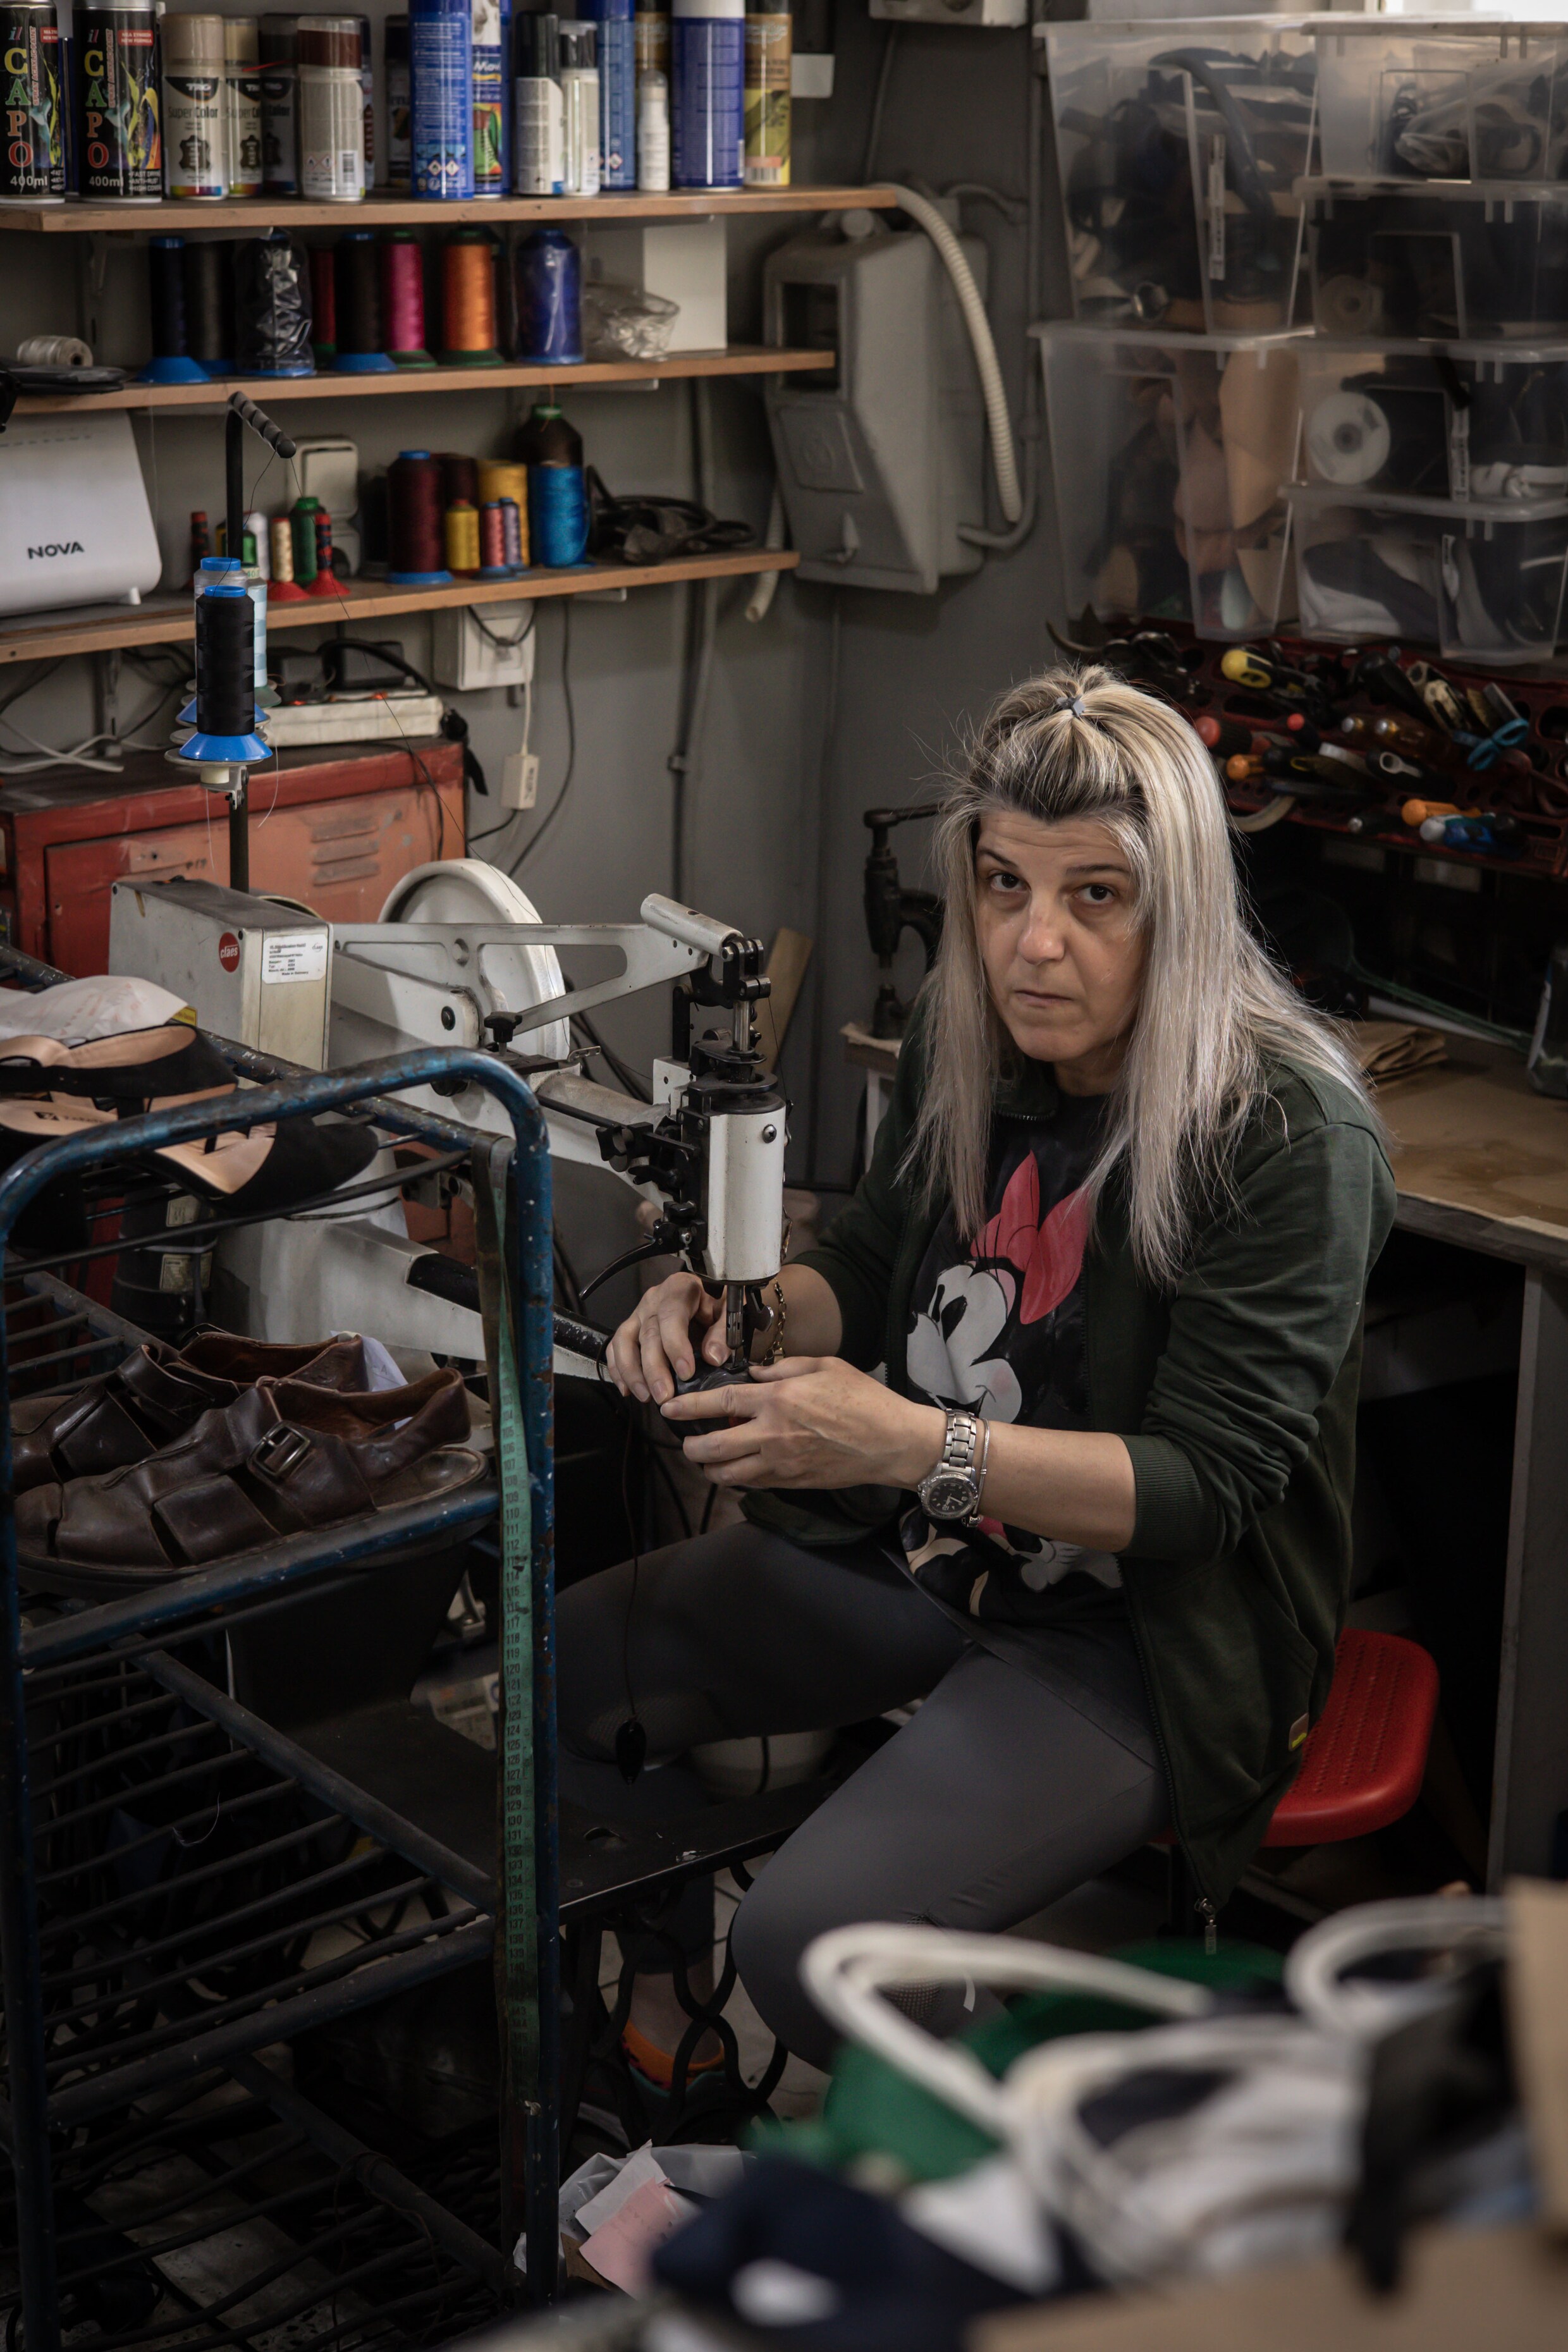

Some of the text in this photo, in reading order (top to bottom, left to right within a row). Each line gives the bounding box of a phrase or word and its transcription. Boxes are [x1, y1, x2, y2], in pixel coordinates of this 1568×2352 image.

[168, 106, 218, 119] Super Color
[10, 176, 48, 186] 400ml
[28, 541, 85, 559] NOVA
[221, 945, 238, 959] claes
[506, 1507, 520, 1520] 110
[506, 1524, 518, 1536] 111
[506, 1539, 519, 1551] 112
[507, 1615, 520, 1629] 117
[506, 1632, 520, 1644] 118
[507, 1648, 520, 1660] 119
[506, 1663, 520, 1675] 120
[507, 1679, 520, 1692] 121
[508, 1694, 521, 1706] 122
[508, 1710, 521, 1722] 123
[507, 1725, 520, 1737] 124
[507, 1739, 520, 1751] 125
[507, 1768, 520, 1780] 127
[506, 1784, 522, 1796] 128
[507, 1799, 522, 1812] 129
[508, 1815, 522, 1826] 130
[508, 1830, 522, 1841] 131
[508, 1859, 522, 1871] 133
[508, 1873, 522, 1887] 134
[510, 1918, 524, 1930] 137
